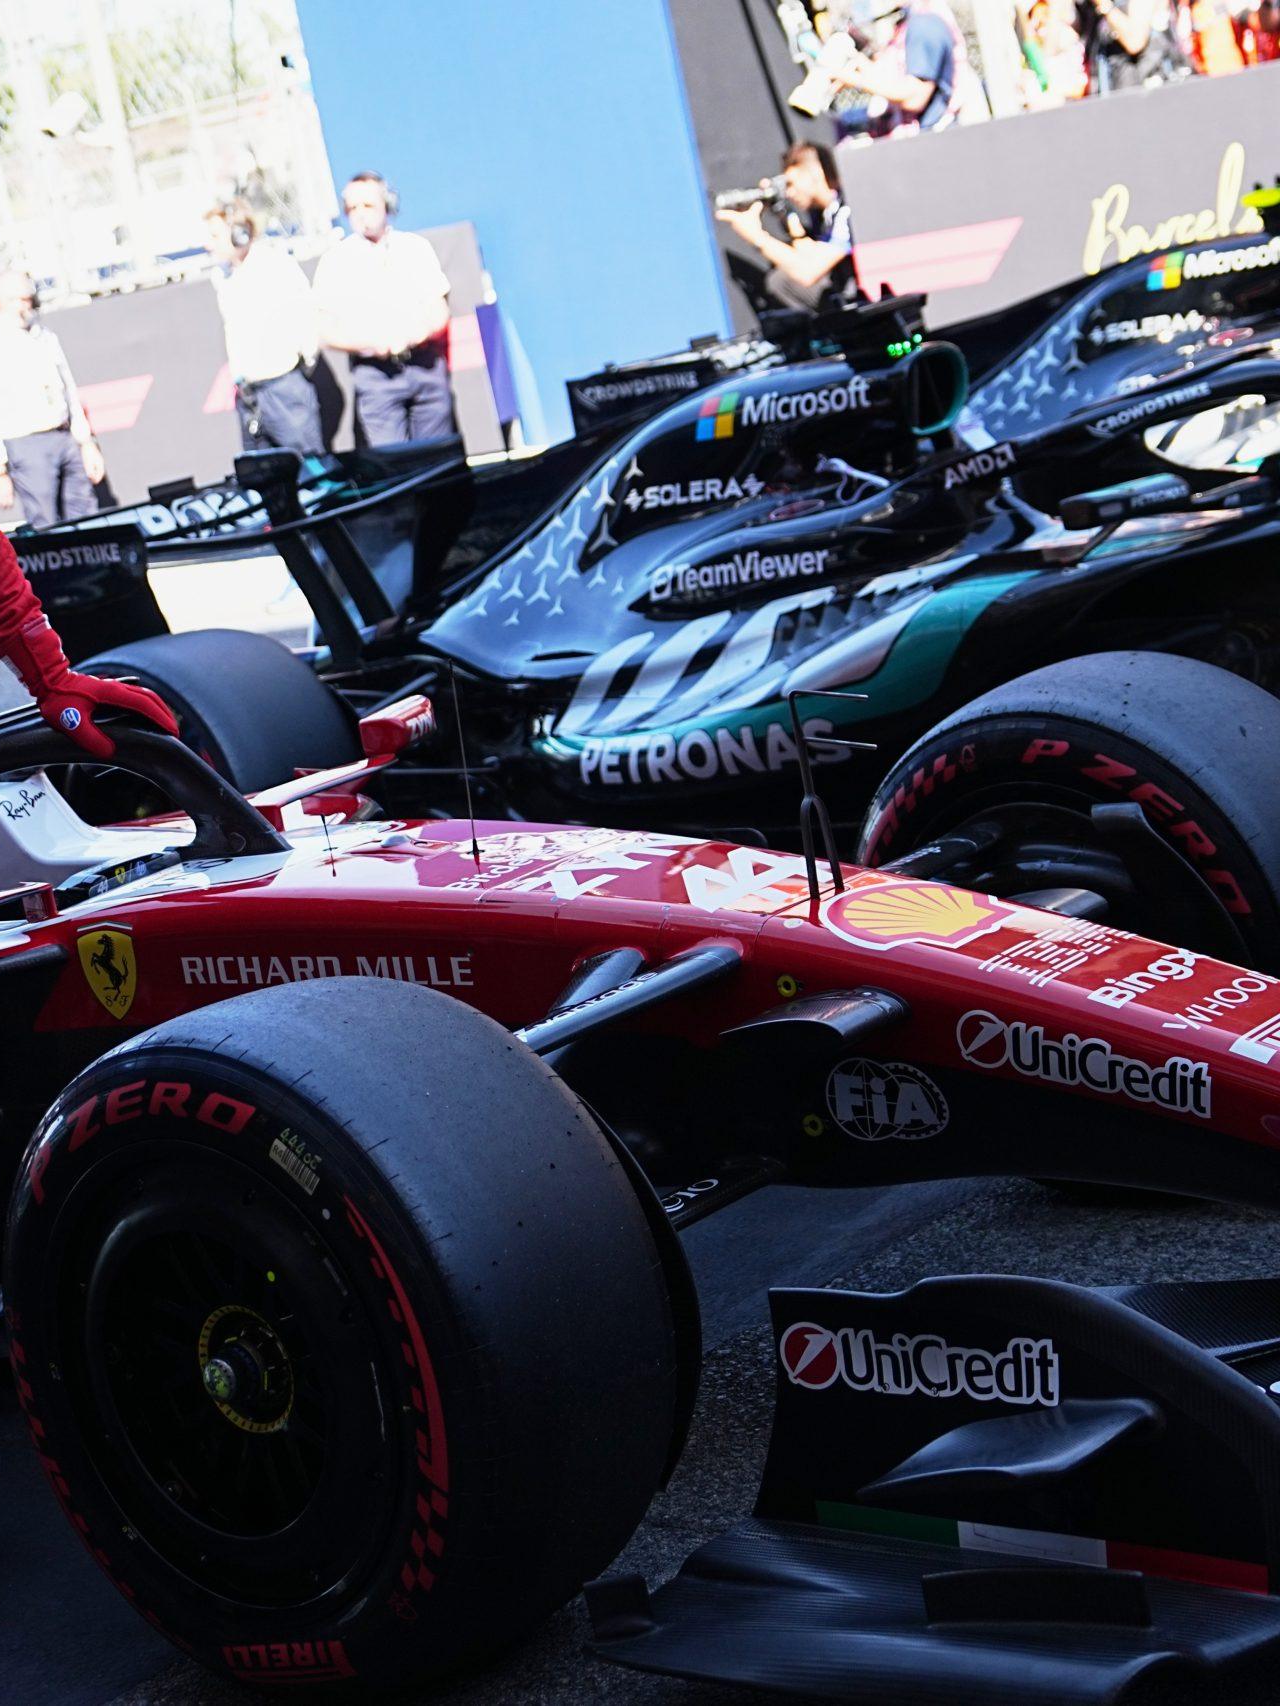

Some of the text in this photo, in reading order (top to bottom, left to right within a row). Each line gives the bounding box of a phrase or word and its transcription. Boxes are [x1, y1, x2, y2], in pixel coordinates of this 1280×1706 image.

[586, 371, 699, 402] CROWDSTRIKE
[740, 375, 872, 428] Microsoft
[945, 452, 994, 489] AMD
[642, 478, 745, 511] SOLERA
[671, 550, 828, 592] TeamViewer
[580, 718, 853, 786] PETRONAS
[1021, 738, 1070, 764] P
[181, 956, 474, 986] RICHARD MILLE
[1009, 1023, 1211, 1117] UniCredit
[66, 1079, 257, 1153] ZERO
[840, 1327, 1059, 1406] UniCredit
